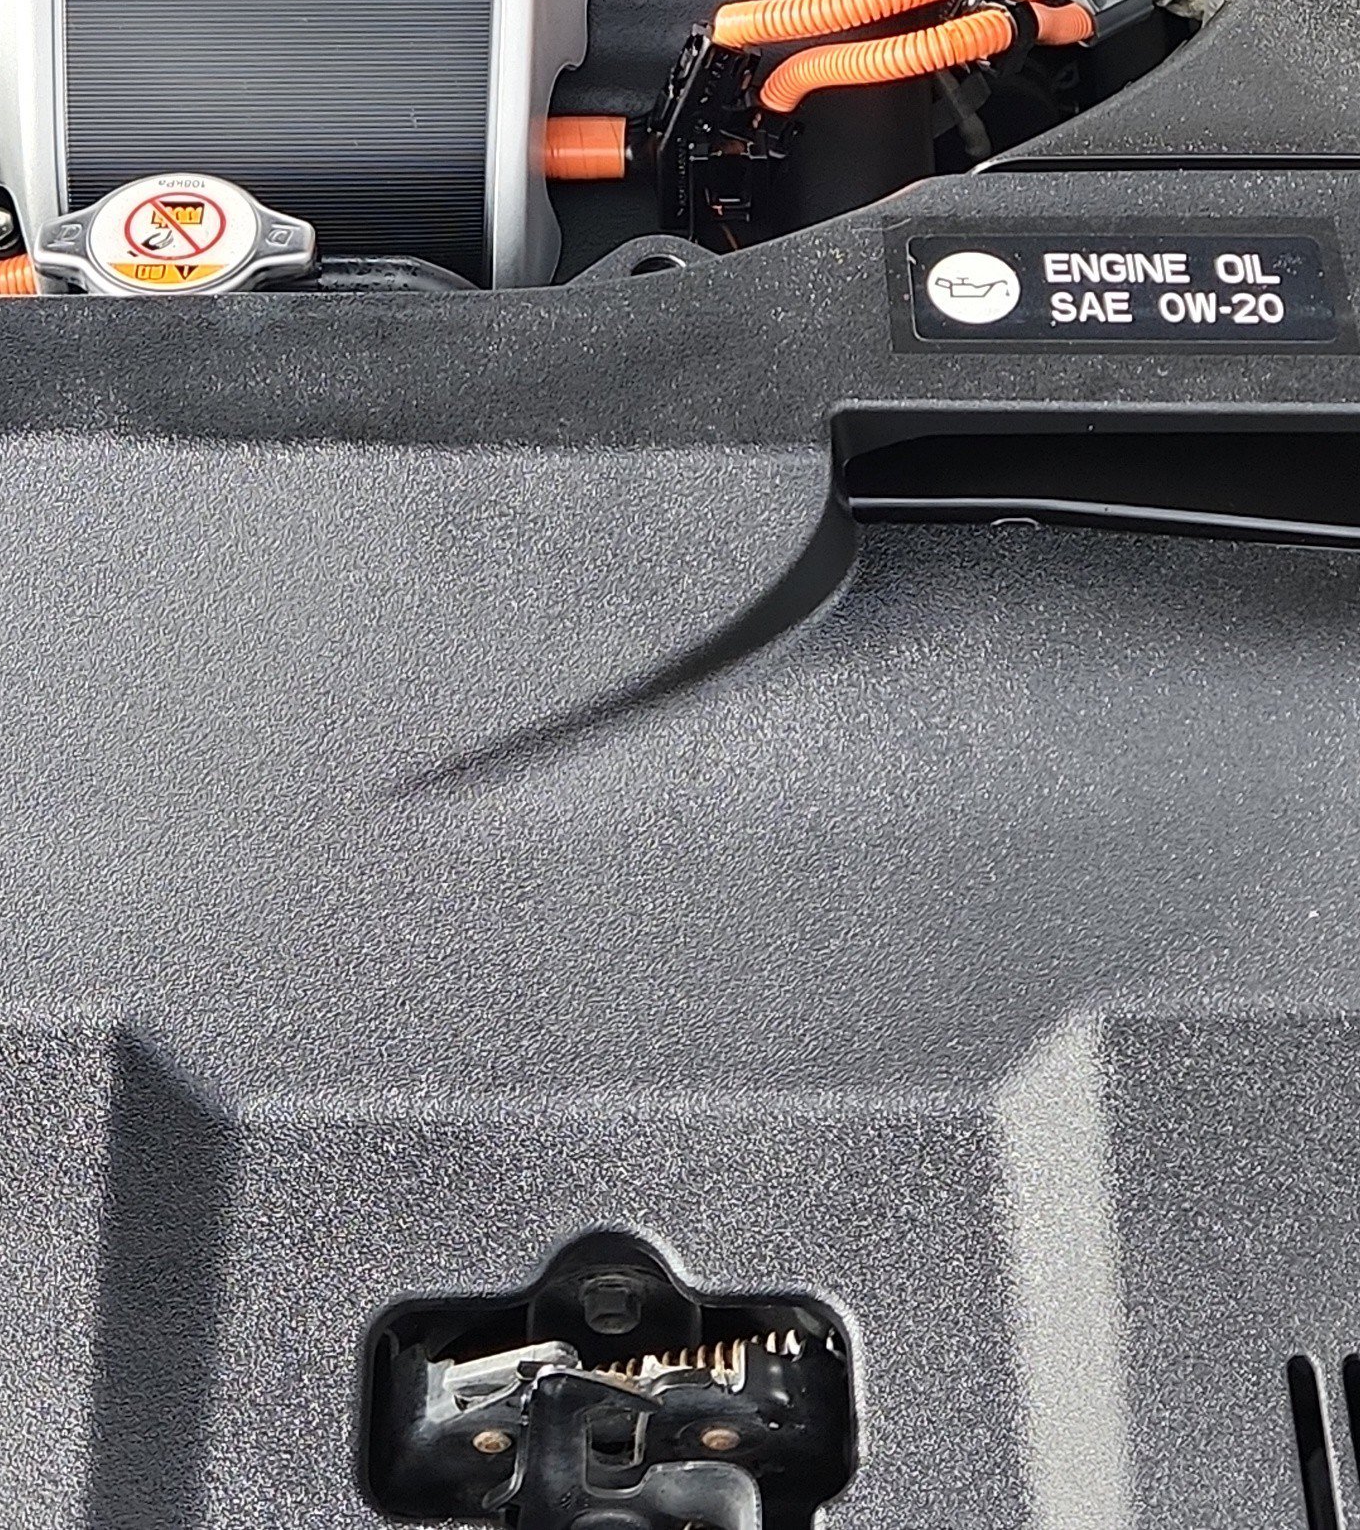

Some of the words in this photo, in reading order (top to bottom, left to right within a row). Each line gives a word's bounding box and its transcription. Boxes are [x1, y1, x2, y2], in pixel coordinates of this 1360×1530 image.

[1043, 253, 1190, 284] ENGINE
[1215, 253, 1281, 285] OIL
[1050, 292, 1133, 323] SAE
[1158, 292, 1285, 324] 0W-20
